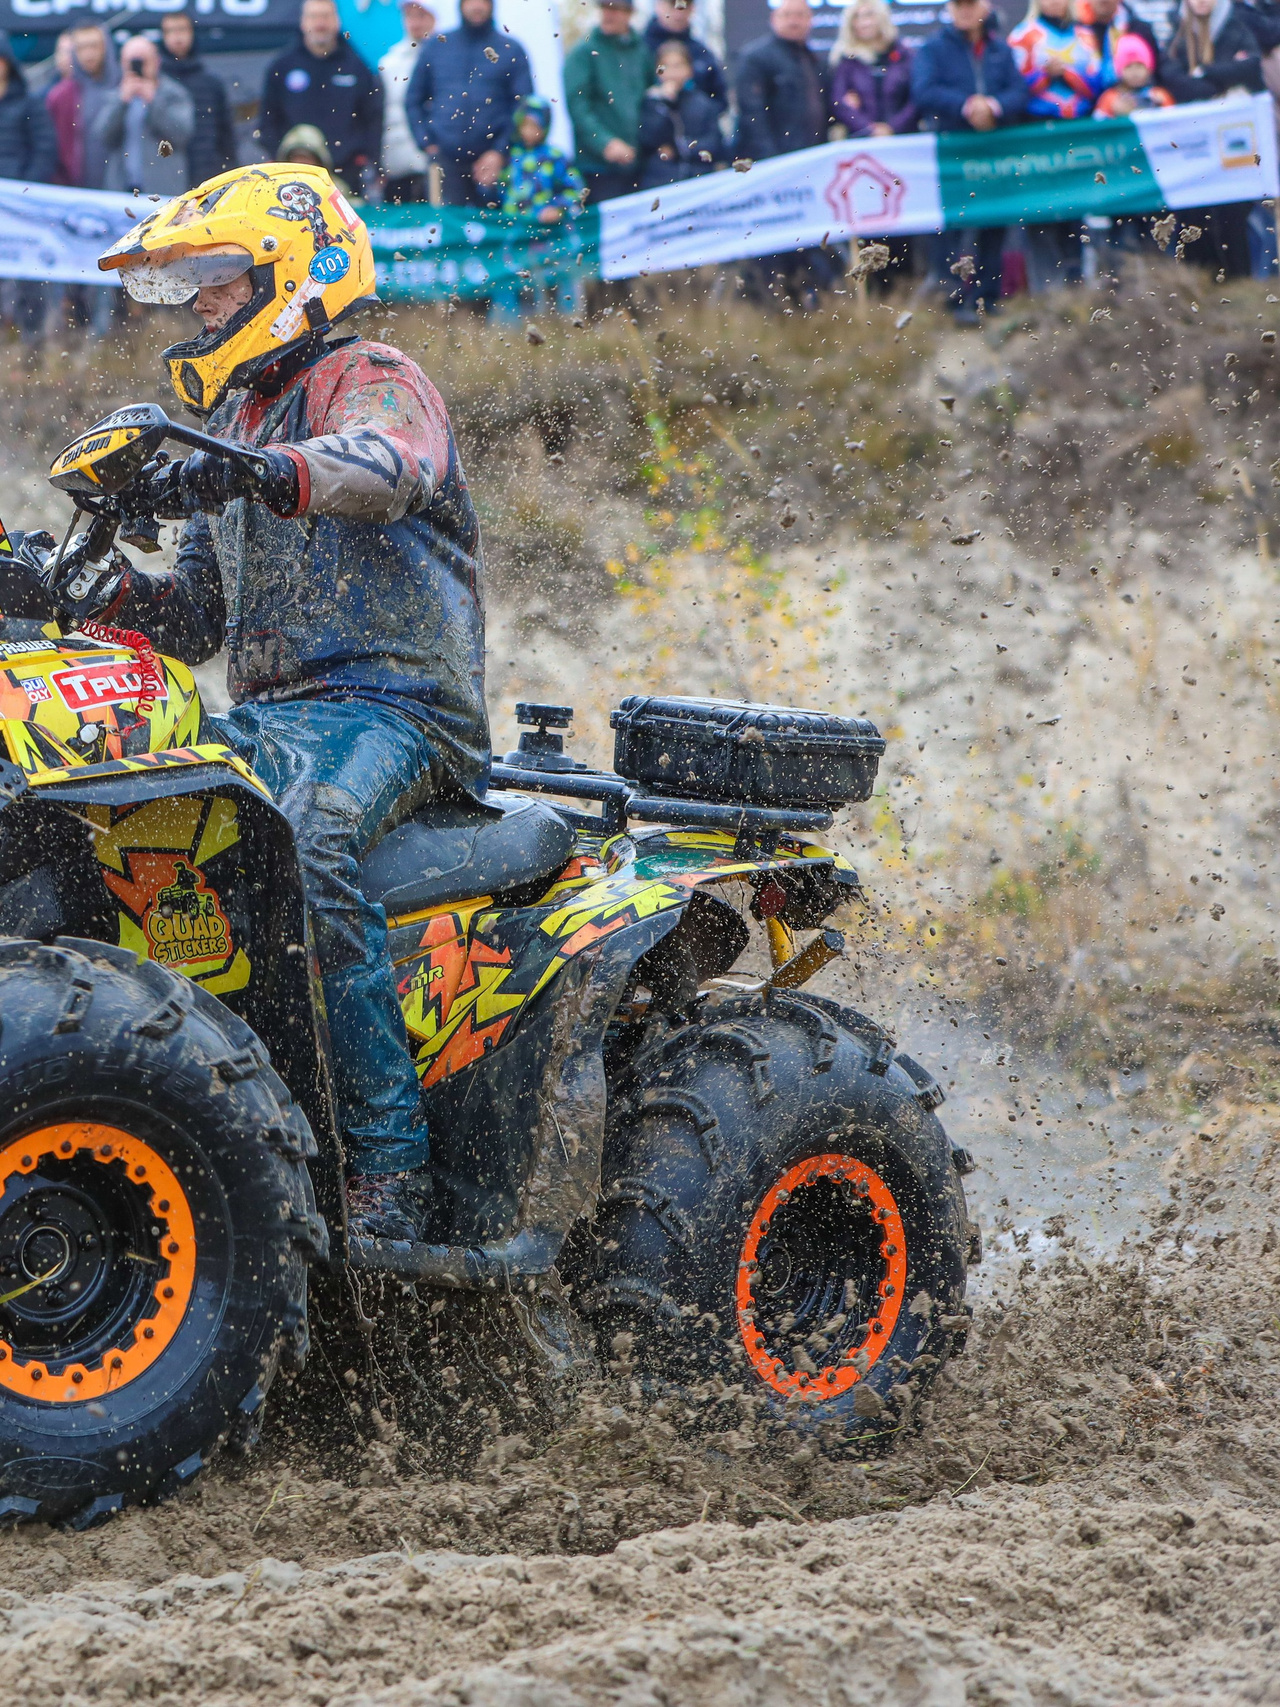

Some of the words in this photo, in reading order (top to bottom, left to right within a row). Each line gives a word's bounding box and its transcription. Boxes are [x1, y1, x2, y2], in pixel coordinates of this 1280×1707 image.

[317, 253, 345, 276] 101
[149, 910, 225, 943] QUAD
[155, 937, 228, 964] STICKERS
